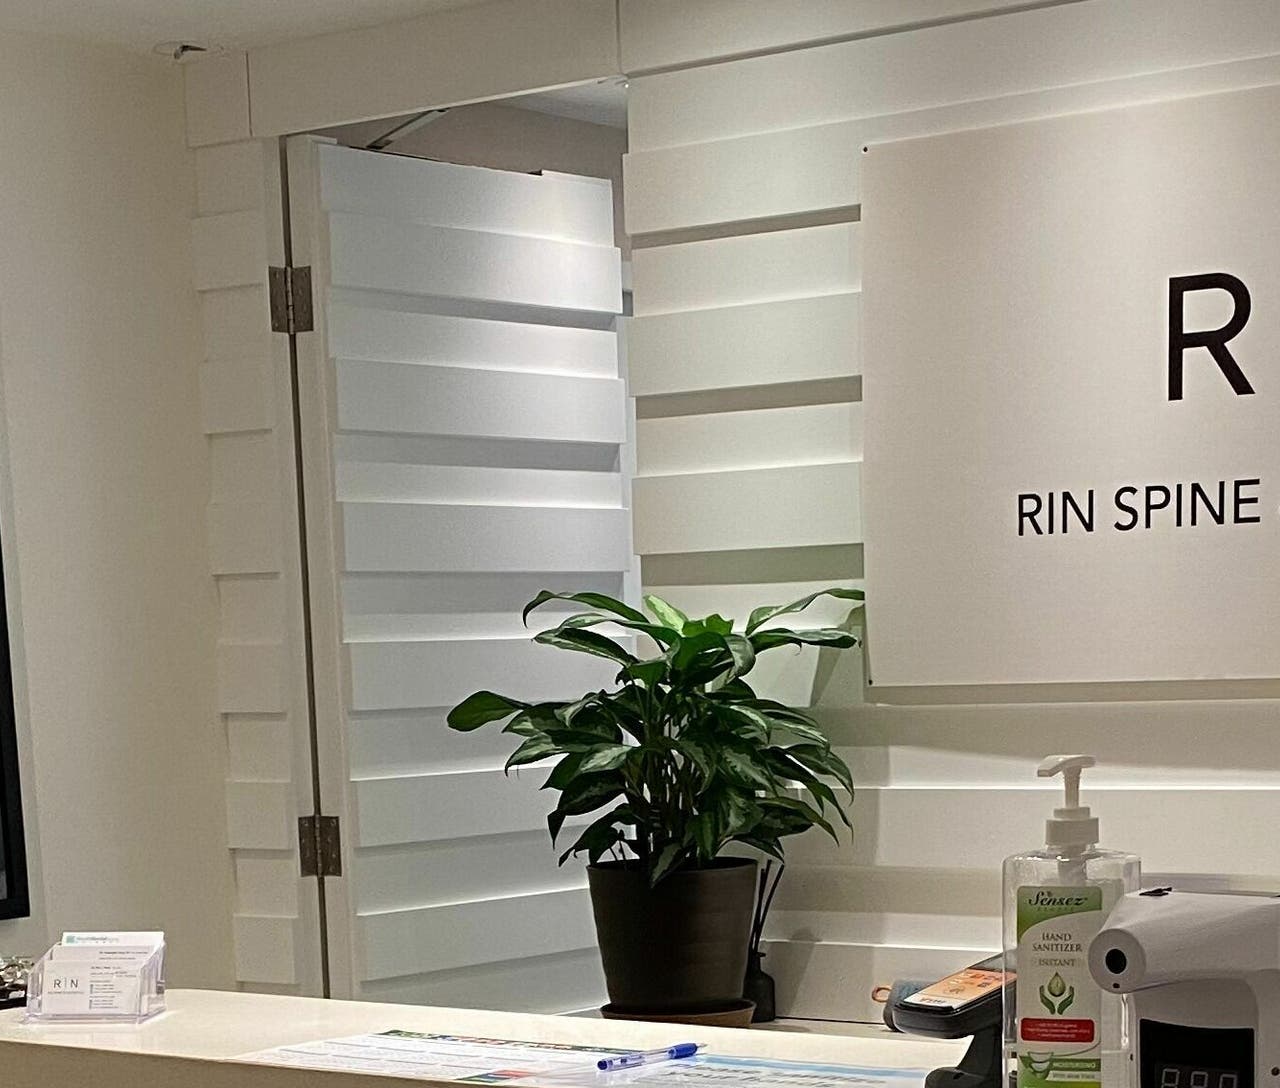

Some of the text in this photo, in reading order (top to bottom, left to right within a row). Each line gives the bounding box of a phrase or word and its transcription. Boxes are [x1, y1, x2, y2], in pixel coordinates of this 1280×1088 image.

[1017, 488, 1095, 537] RIN
[1113, 477, 1262, 532] SPINE
[1042, 931, 1072, 942] HAND
[1031, 942, 1083, 953] SANITIZER
[661, 1071, 834, 1088] your hands
[668, 1063, 887, 1084] Please sanitize
